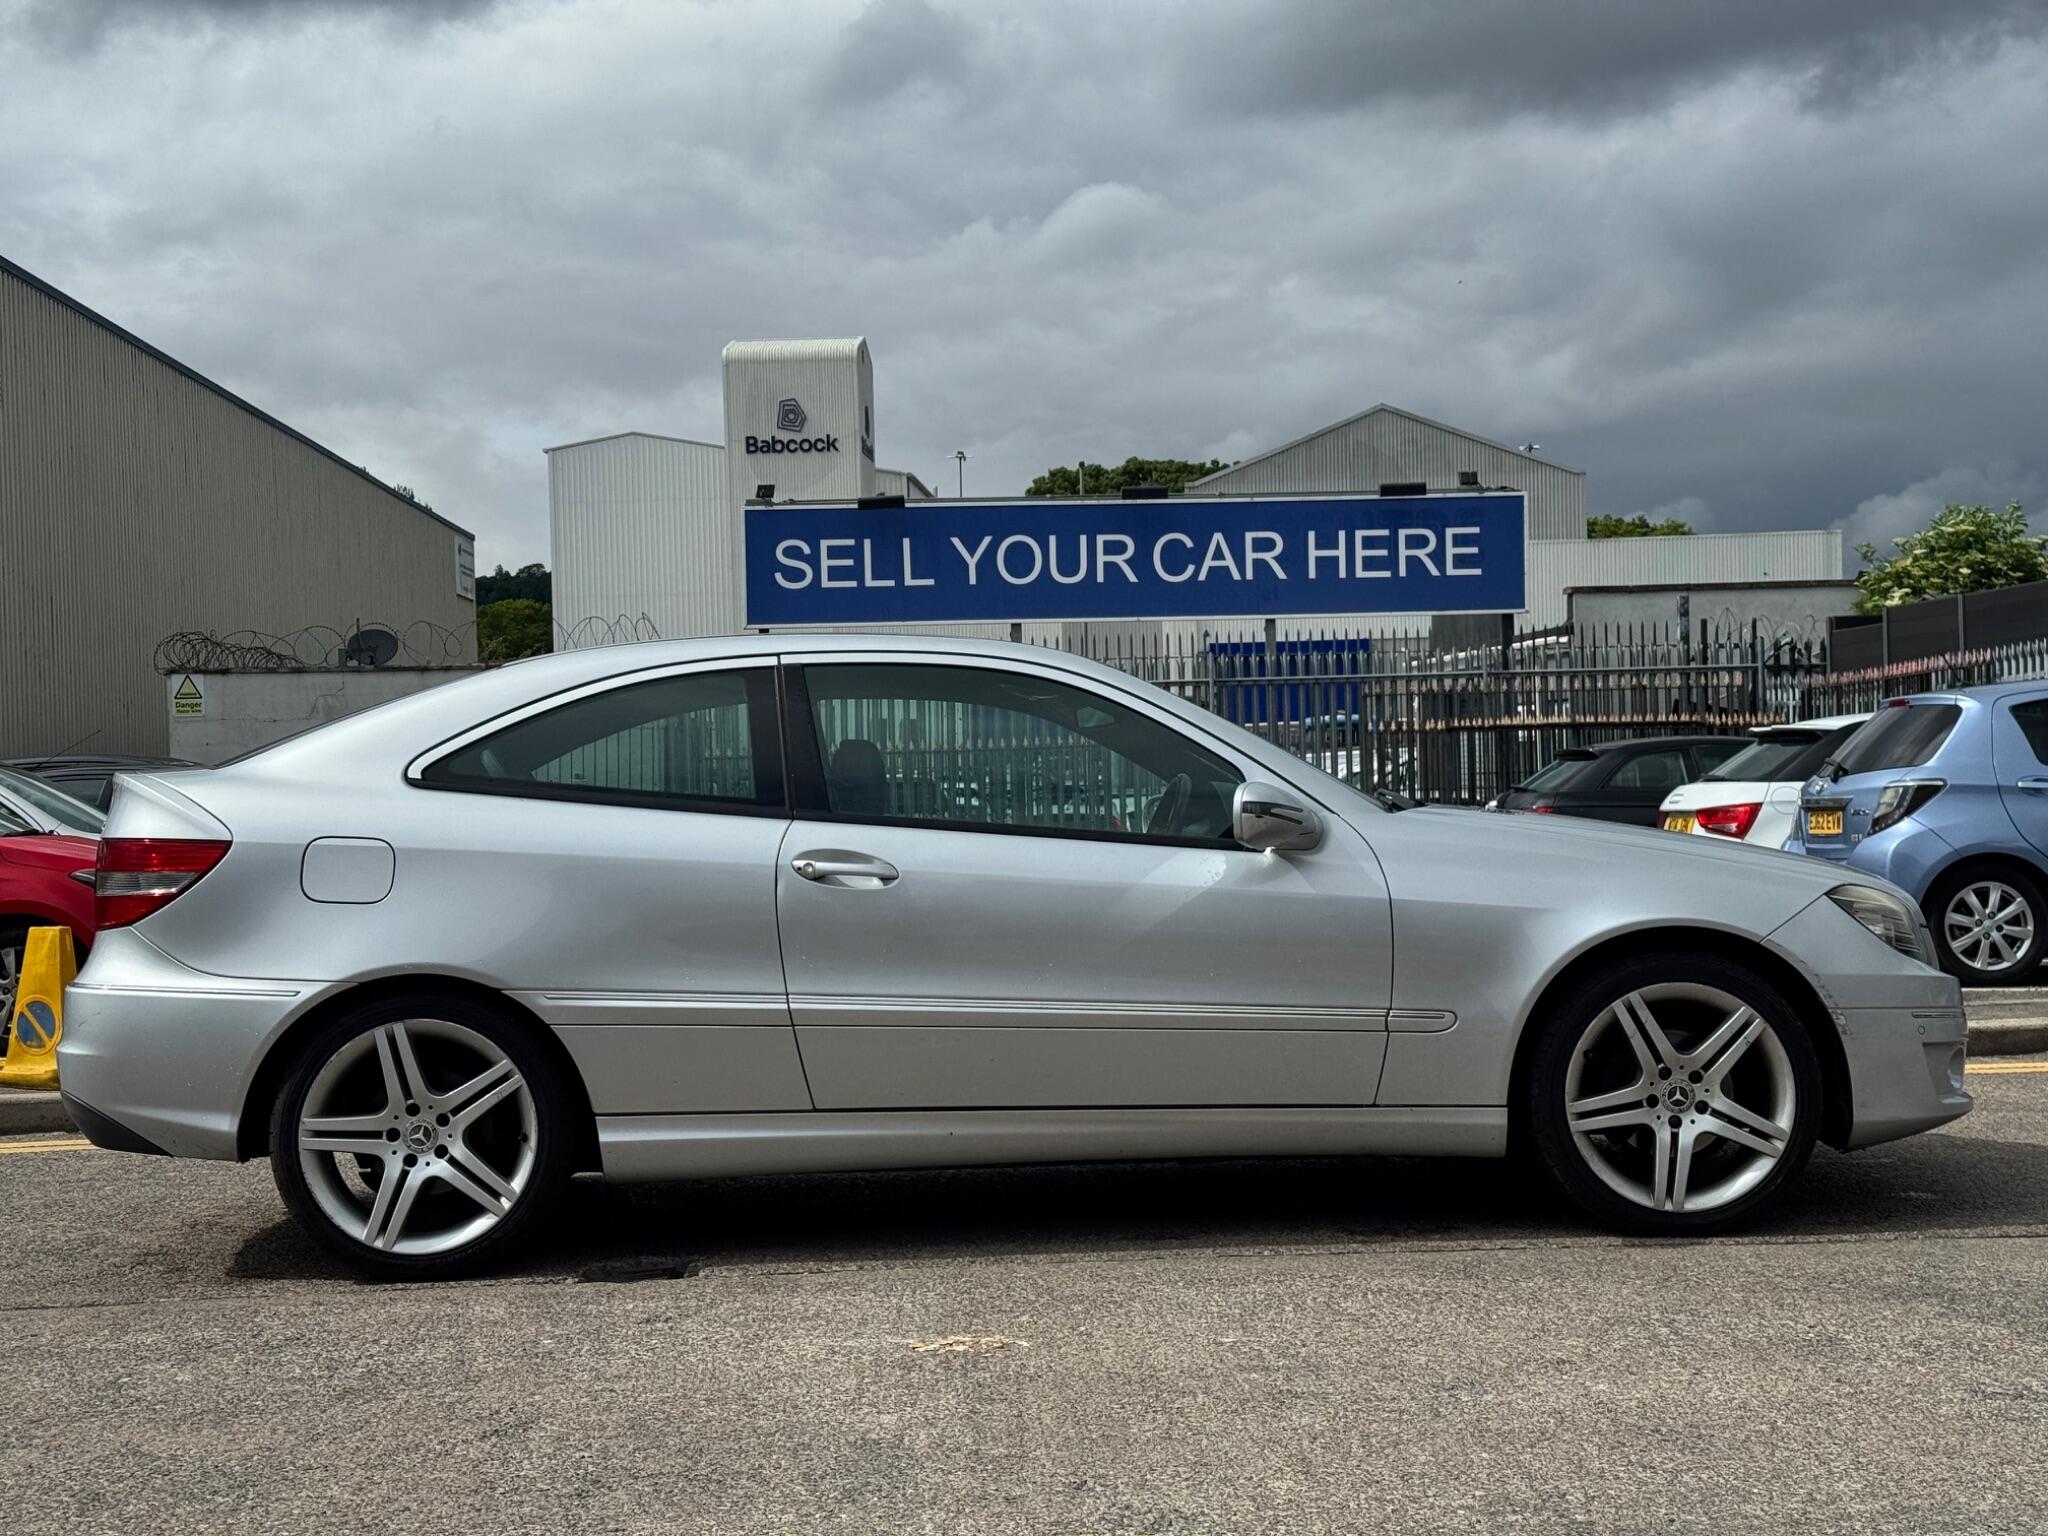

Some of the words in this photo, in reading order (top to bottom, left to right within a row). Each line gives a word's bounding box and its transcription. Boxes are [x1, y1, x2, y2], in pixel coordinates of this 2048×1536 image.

[745, 434, 839, 455] Babcock
[774, 538, 935, 590] SELL
[950, 533, 1138, 586] YOUR
[1152, 531, 1287, 582] CAR
[1307, 526, 1483, 579] HERE
